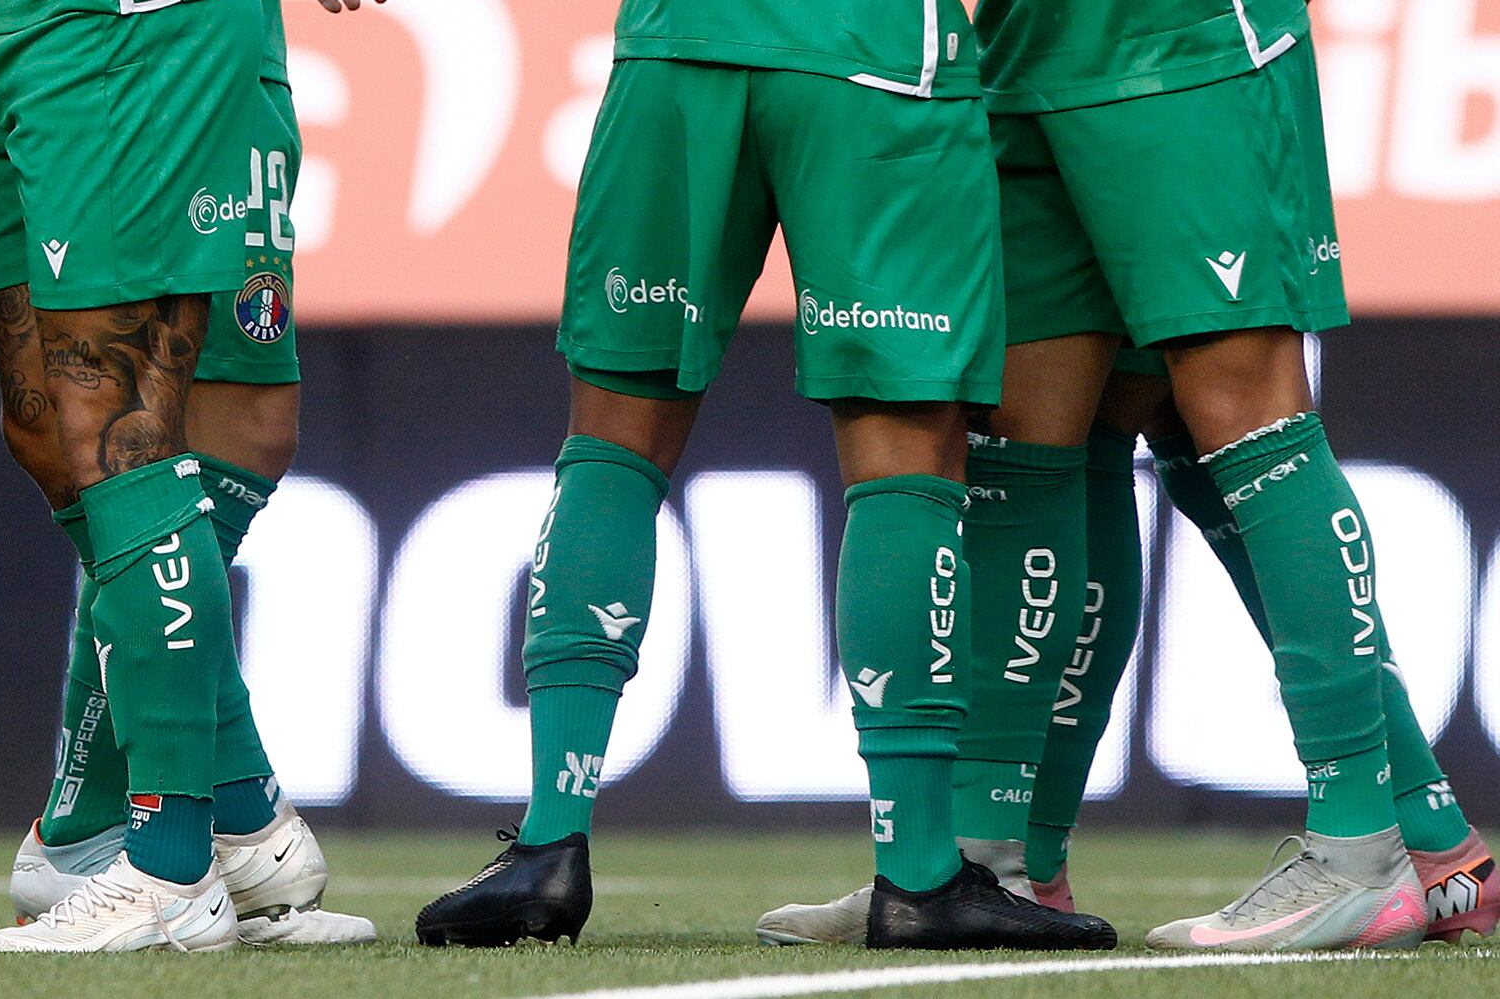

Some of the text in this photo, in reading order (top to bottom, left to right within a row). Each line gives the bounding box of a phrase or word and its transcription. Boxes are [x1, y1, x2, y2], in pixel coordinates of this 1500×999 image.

[819, 299, 951, 334] defontana
[929, 545, 958, 685] IVECO
[1003, 547, 1058, 685] IVECO
[1329, 507, 1376, 656] IVECO
